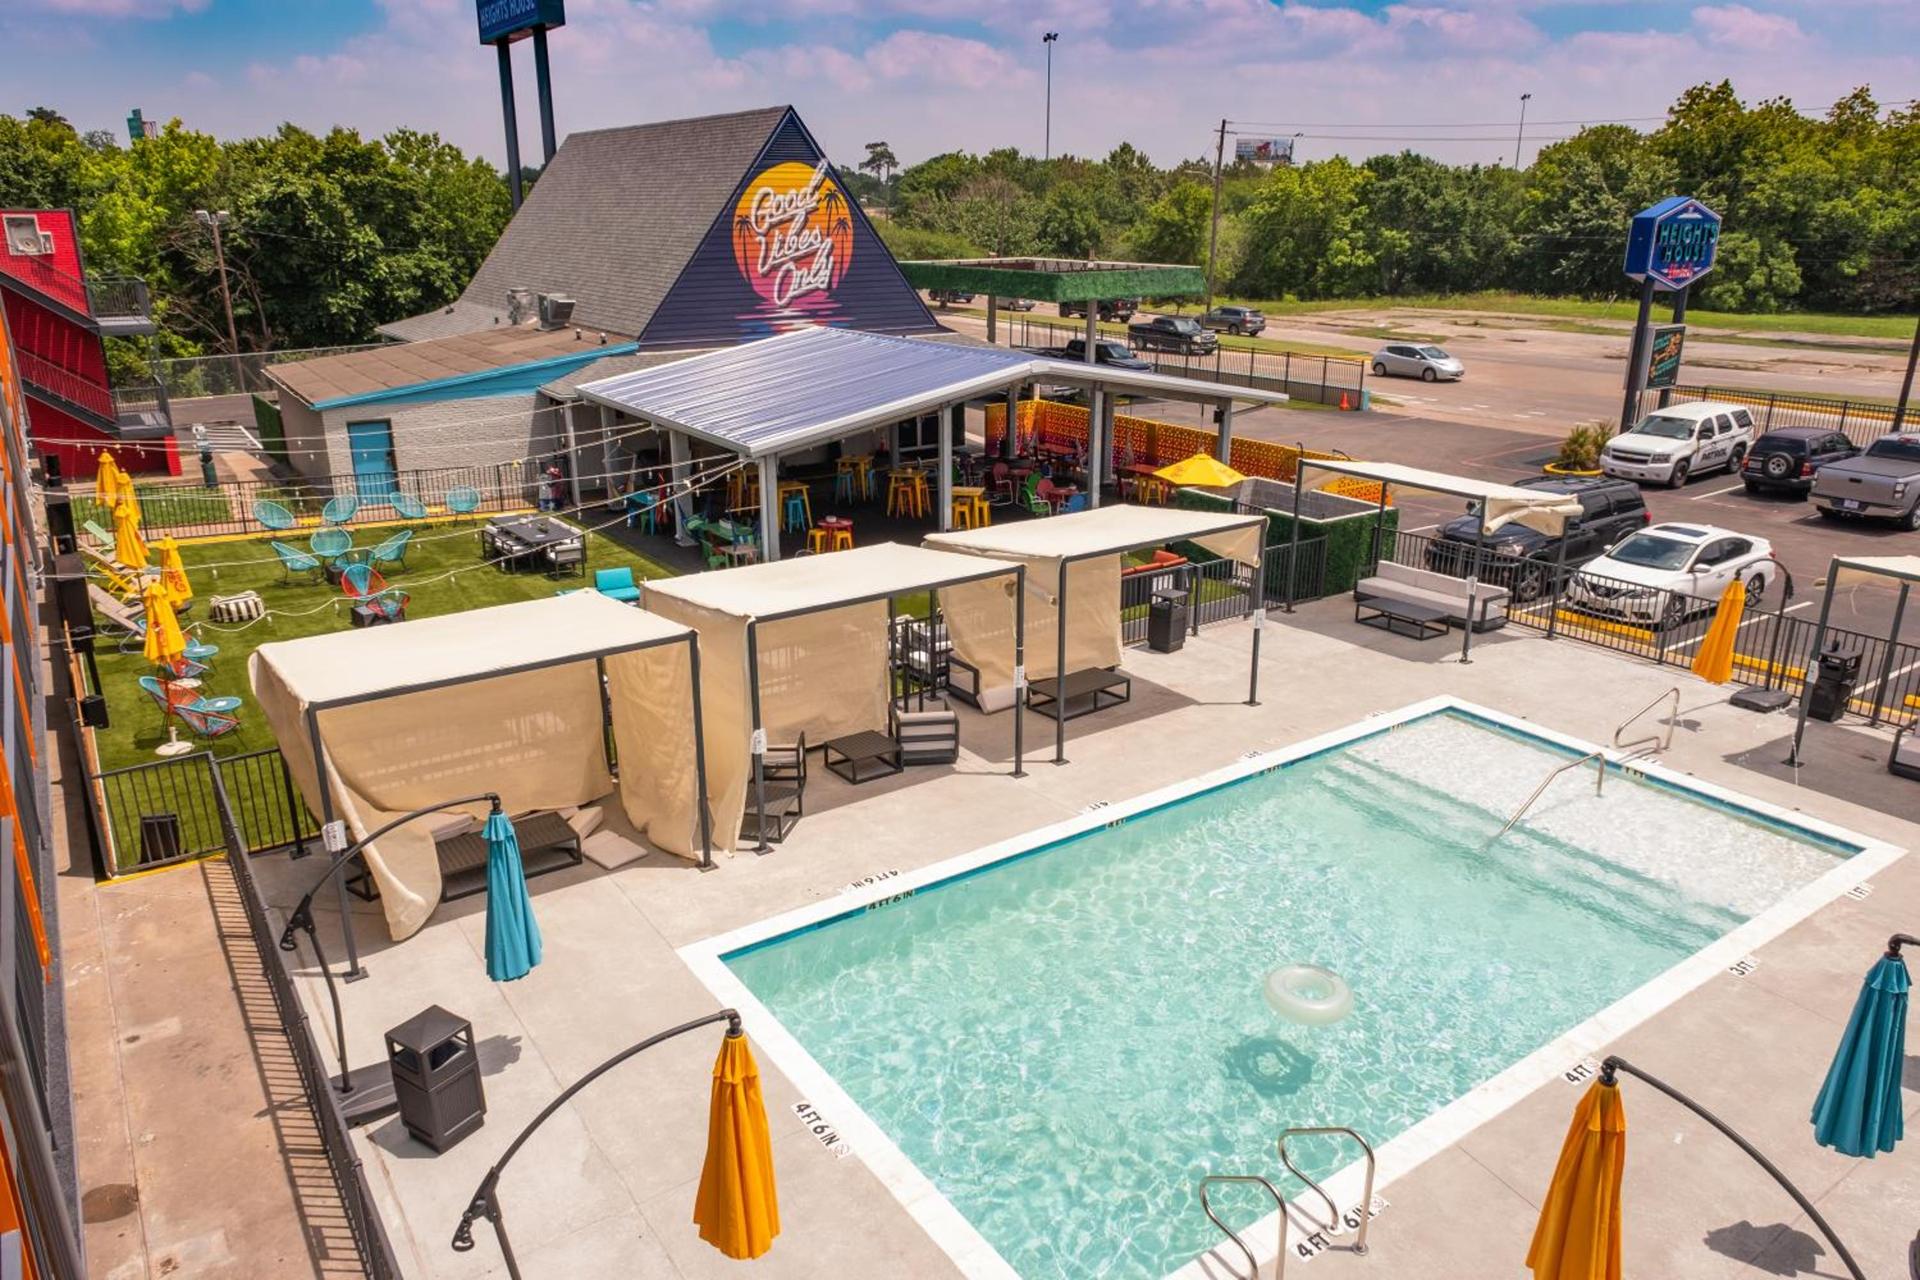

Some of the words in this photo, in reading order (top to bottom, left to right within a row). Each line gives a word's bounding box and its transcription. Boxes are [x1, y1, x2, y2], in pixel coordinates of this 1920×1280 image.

[751, 158, 829, 235] Good
[754, 210, 822, 275] Vibes
[1659, 223, 1719, 246] HEIGHTS
[773, 238, 834, 307] Only
